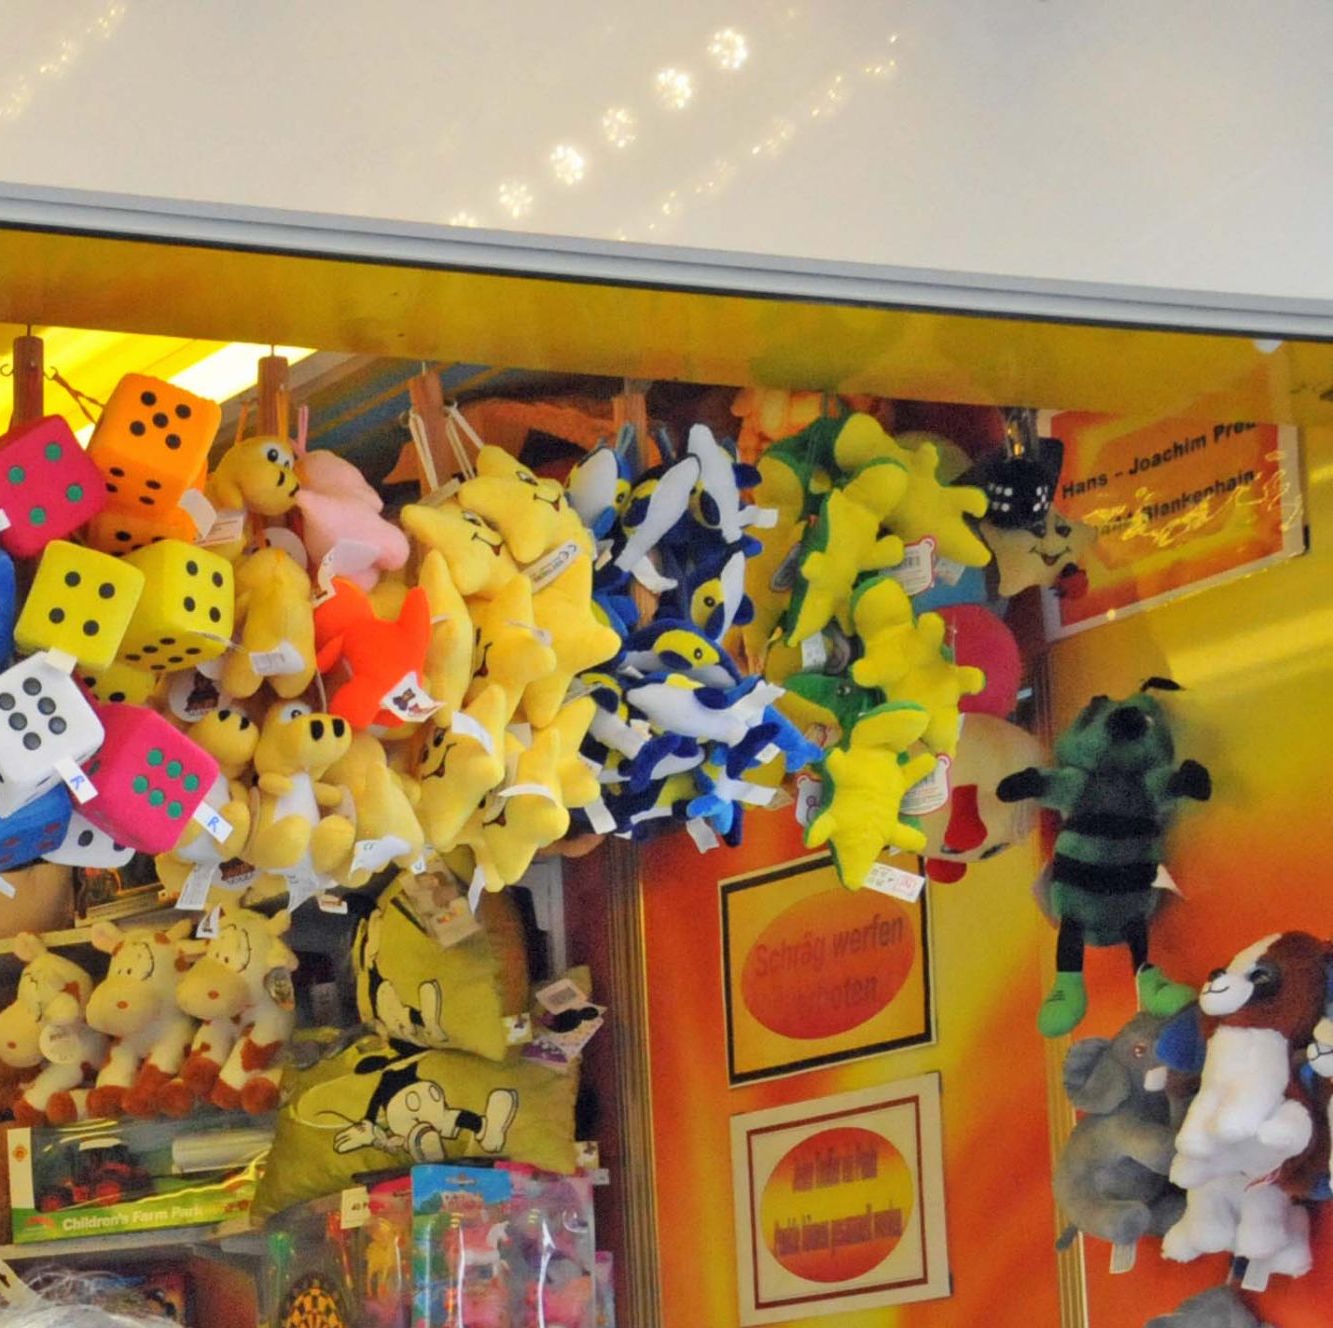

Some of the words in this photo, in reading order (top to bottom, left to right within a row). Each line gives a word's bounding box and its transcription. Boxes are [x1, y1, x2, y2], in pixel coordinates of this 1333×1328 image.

[1061, 472, 1109, 499] Hans
[1129, 435, 1207, 476] Joachim
[833, 912, 904, 960] werfen
[62, 1209, 130, 1232] Children's
[132, 1206, 168, 1225] Farm
[172, 1205, 203, 1222] Park
